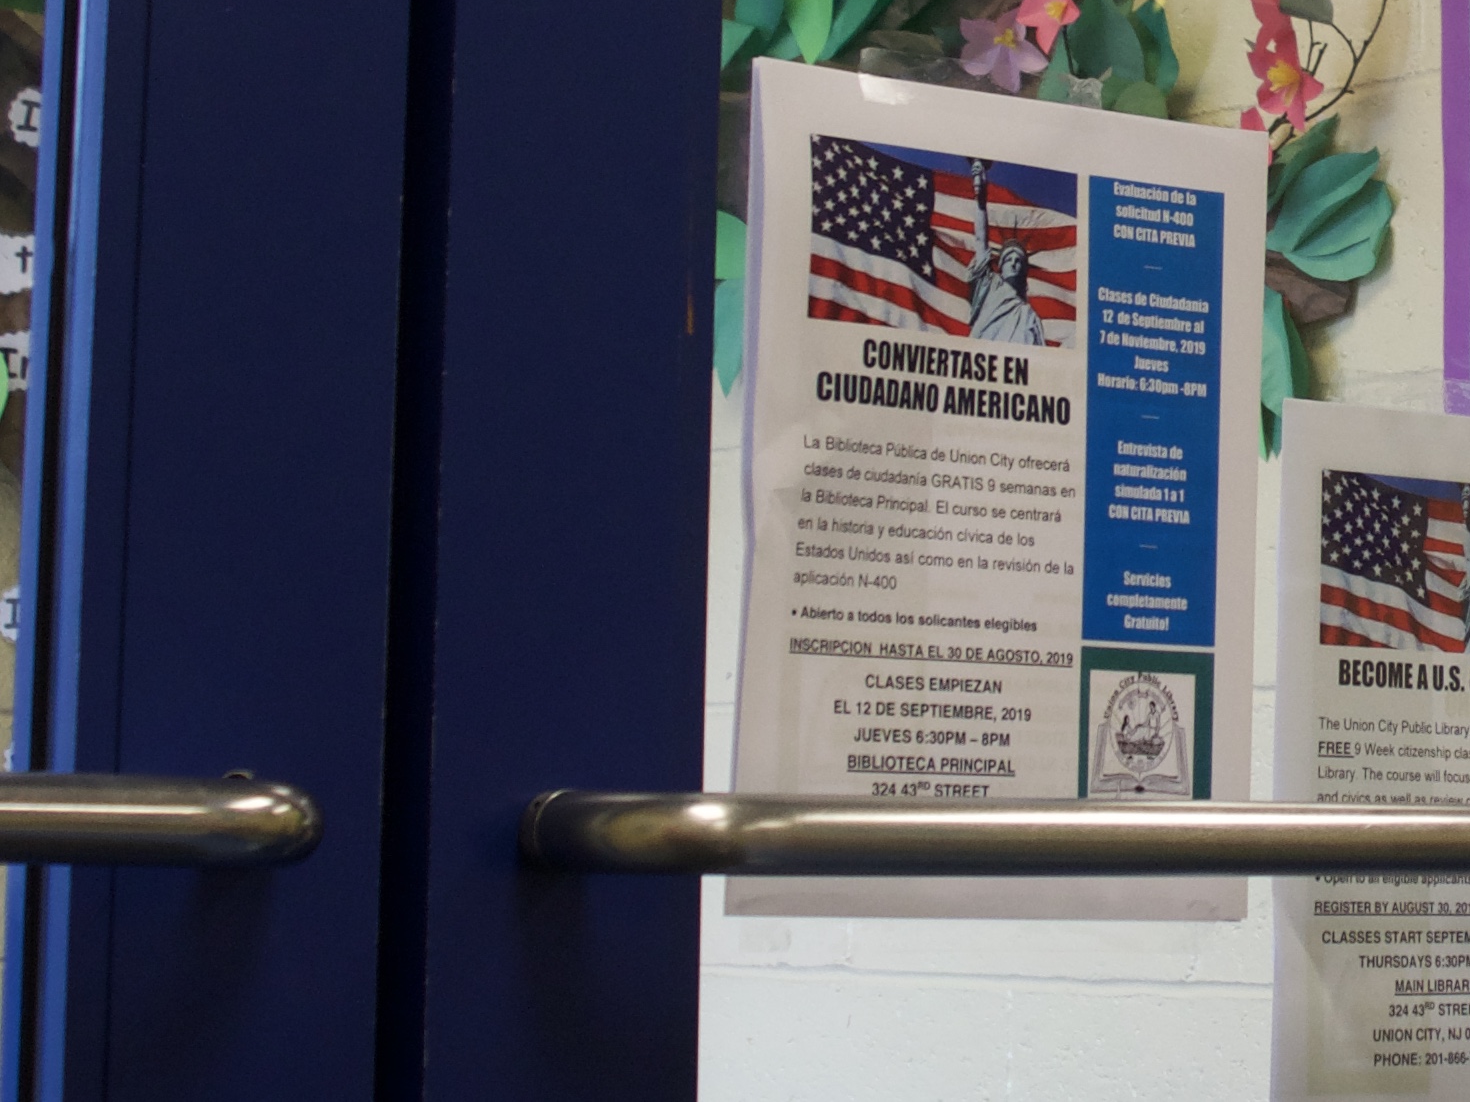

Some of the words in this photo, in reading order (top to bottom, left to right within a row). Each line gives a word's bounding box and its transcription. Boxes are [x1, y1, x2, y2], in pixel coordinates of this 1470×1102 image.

[1114, 225, 1134, 240] CON
[1136, 227, 1158, 243] CITA
[1160, 229, 1195, 248] PREVIA
[863, 339, 997, 382] CONVIERTASE
[1004, 356, 1029, 385] EN
[1134, 355, 1168, 373] Jueves
[817, 372, 938, 412] CIUDADANO
[944, 386, 1071, 425] AMERICANO
[804, 435, 820, 449] La
[826, 436, 882, 456] Biblioteca
[886, 442, 926, 460] Pública
[930, 448, 946, 461] de
[950, 450, 986, 465] Union
[990, 453, 1014, 470] City
[1018, 458, 1070, 472] ofrecerá
[794, 570, 854, 586] aplicación
[858, 574, 897, 590] N-400
[801, 606, 844, 621] Abierto
[848, 612, 854, 621] a
[858, 610, 891, 624] todos
[896, 612, 914, 624] los
[918, 614, 980, 629] solicantes
[984, 618, 1037, 633] elegibles
[1124, 614, 1169, 631] Gratuito!
[866, 674, 924, 691] CLASES
[930, 677, 1002, 694] EMPIEZAN
[1339, 659, 1412, 689] BECOME
[1418, 663, 1428, 690] A
[1433, 664, 1465, 691] U.S.
[834, 700, 850, 714] EL
[856, 702, 870, 715] 12
[876, 702, 896, 716] DE
[900, 703, 996, 722] SEPTIEMBRE,
[1002, 707, 1031, 721] 2019
[1319, 717, 1340, 730] The
[1344, 719, 1374, 732] Union
[1379, 720, 1398, 736] City
[1402, 722, 1432, 734] Public
[1436, 723, 1469, 737] Library
[848, 755, 936, 772] BIBLIOTECA
[940, 758, 1014, 774] PRINCIPAL
[872, 782, 896, 797] 324
[1314, 902, 1371, 913] REGISTER
[1375, 902, 1388, 913] BY
[1392, 902, 1434, 913] AUGUST
[1438, 903, 1451, 914] 30,
[1322, 931, 1381, 944] CLASSES
[1385, 931, 1422, 943] START
[1395, 980, 1424, 992] MAIN
[1389, 1004, 1408, 1016] 324
[1373, 1029, 1412, 1042] UNION
[1416, 1028, 1445, 1043] CITY,
[1449, 1028, 1462, 1040] NJ
[1374, 1053, 1422, 1066] PHONE:
